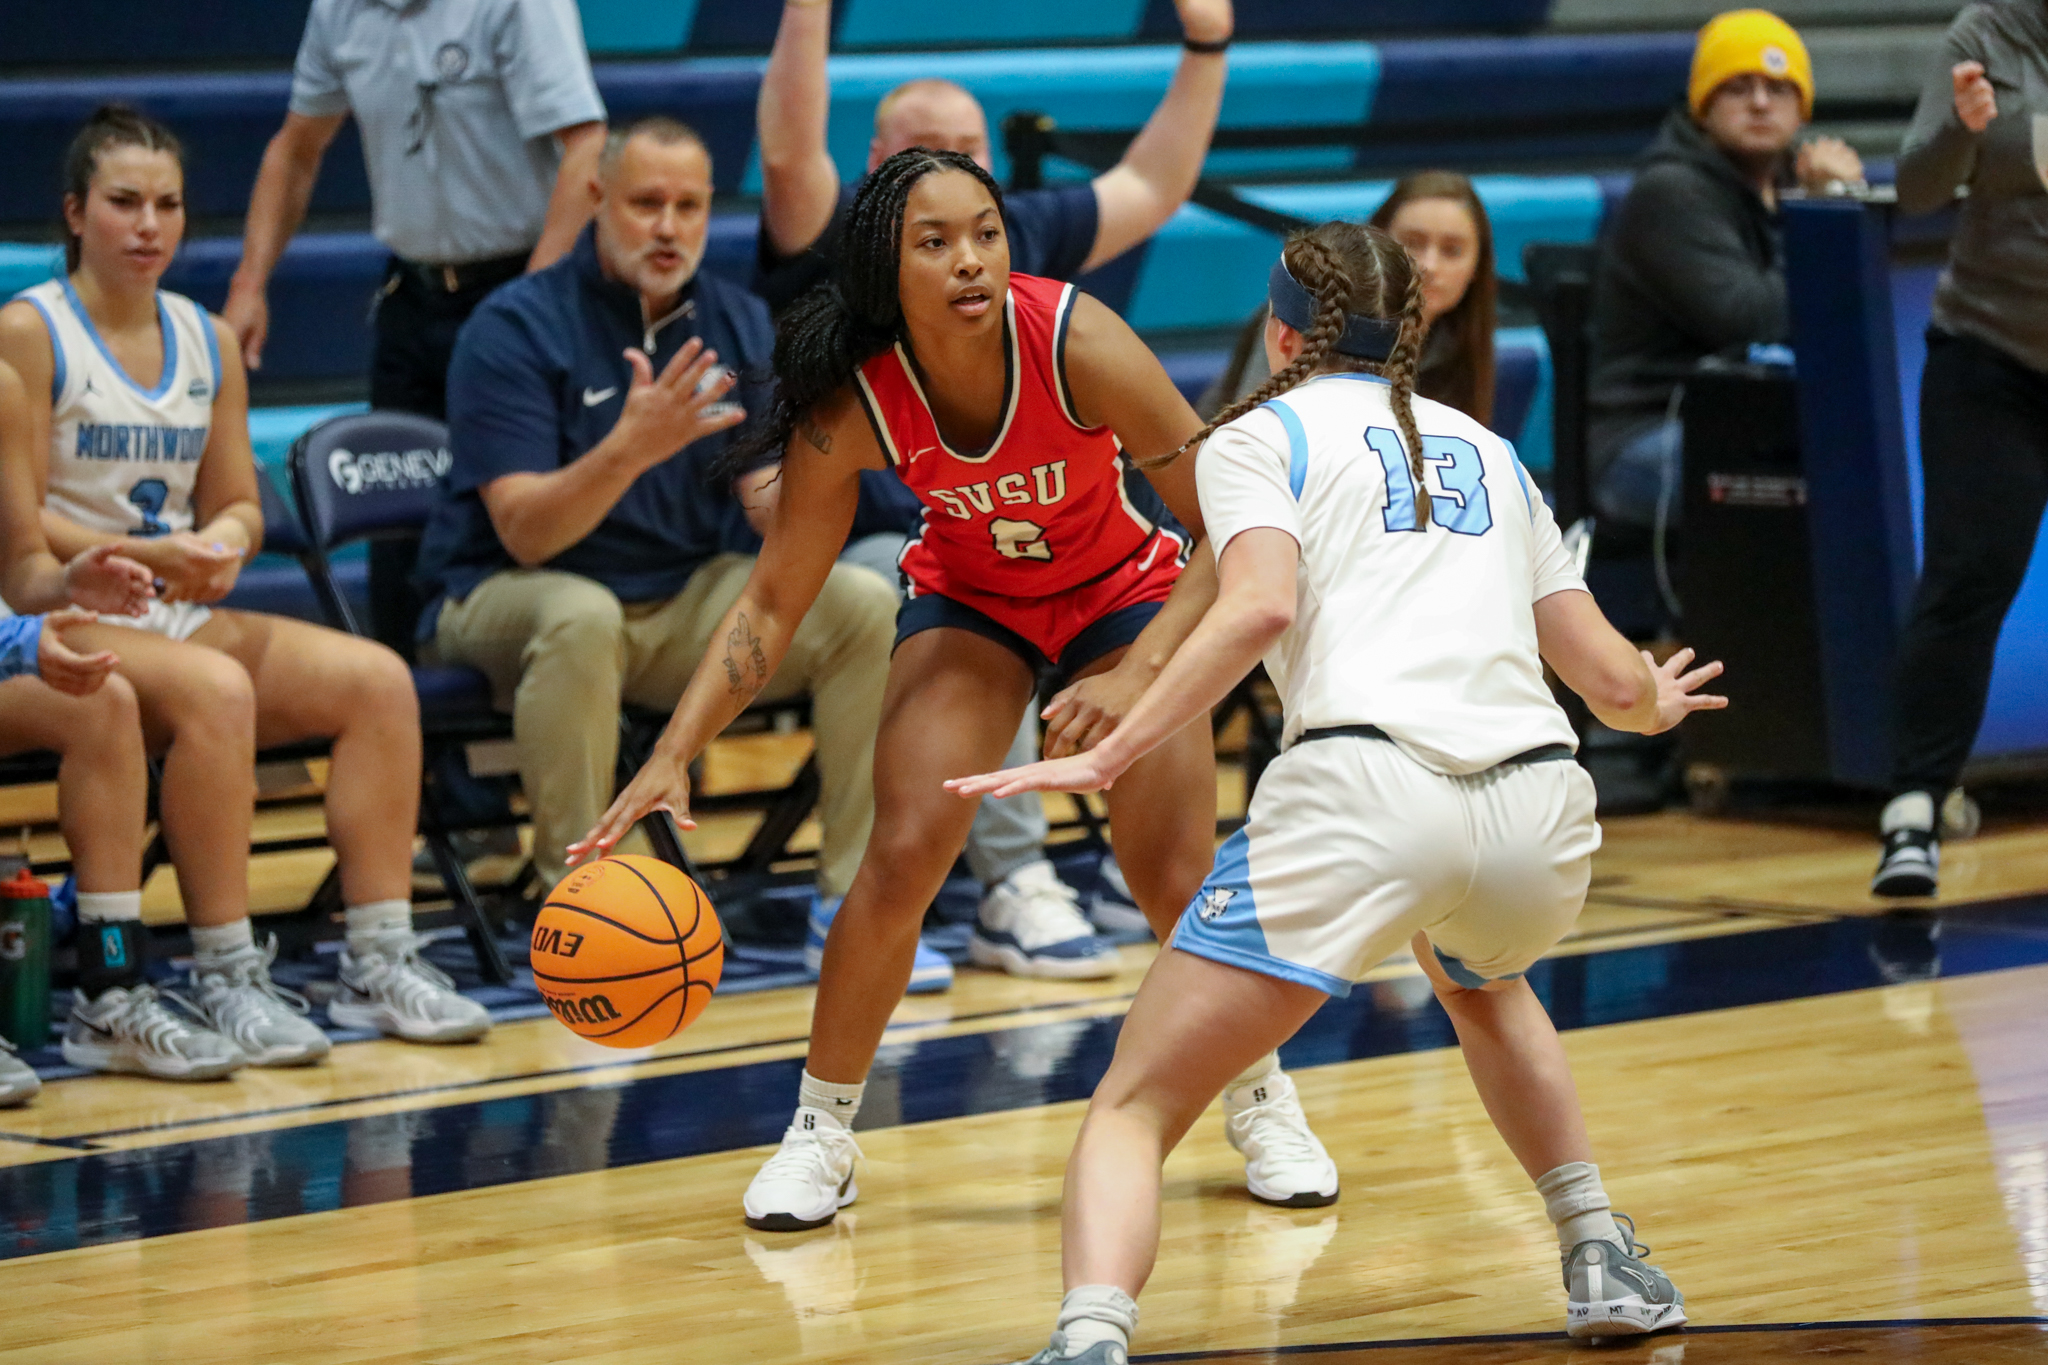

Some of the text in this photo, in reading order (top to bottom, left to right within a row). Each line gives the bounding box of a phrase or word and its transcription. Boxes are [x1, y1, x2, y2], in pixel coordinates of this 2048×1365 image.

[928, 459, 1067, 520] SVSU
[1363, 426, 1494, 536] 13
[533, 926, 585, 958] EVO
[541, 990, 622, 1025] Wils
